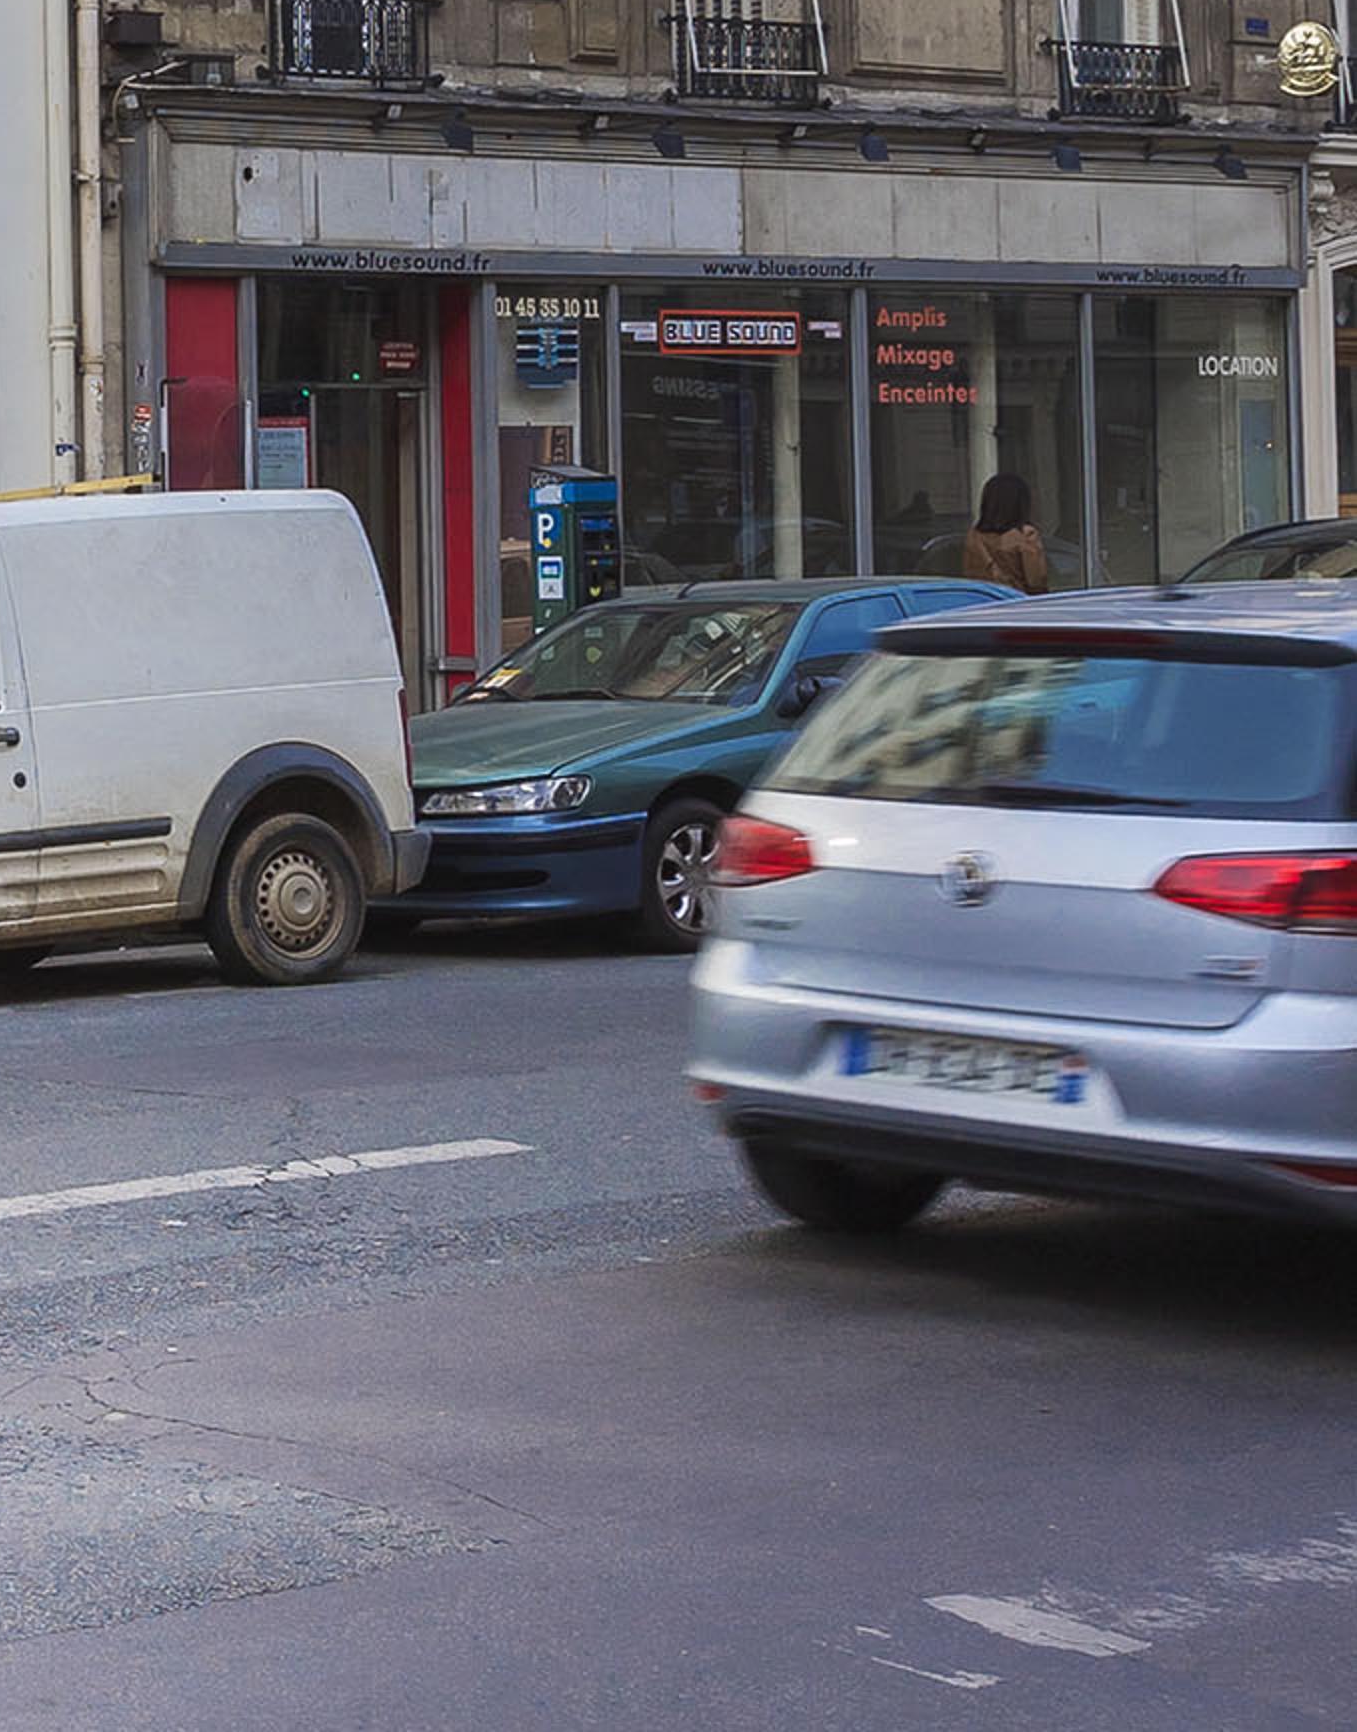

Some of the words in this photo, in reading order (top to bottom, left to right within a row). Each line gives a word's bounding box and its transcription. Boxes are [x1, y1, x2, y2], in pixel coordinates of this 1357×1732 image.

[291, 250, 490, 273] www.bluesound.fr
[702, 260, 876, 279] www.bluesound.fr
[1096, 267, 1248, 286] www.bluesound.fr
[494, 296, 513, 318] 01
[562, 297, 581, 319] 10
[583, 298, 601, 319] 11
[875, 306, 947, 332] Amplis
[664, 319, 721, 345] BLUE
[727, 320, 797, 346] SOUND
[876, 344, 956, 371] Mixage
[1197, 355, 1279, 376] LOCATION
[537, 512, 555, 546] P
